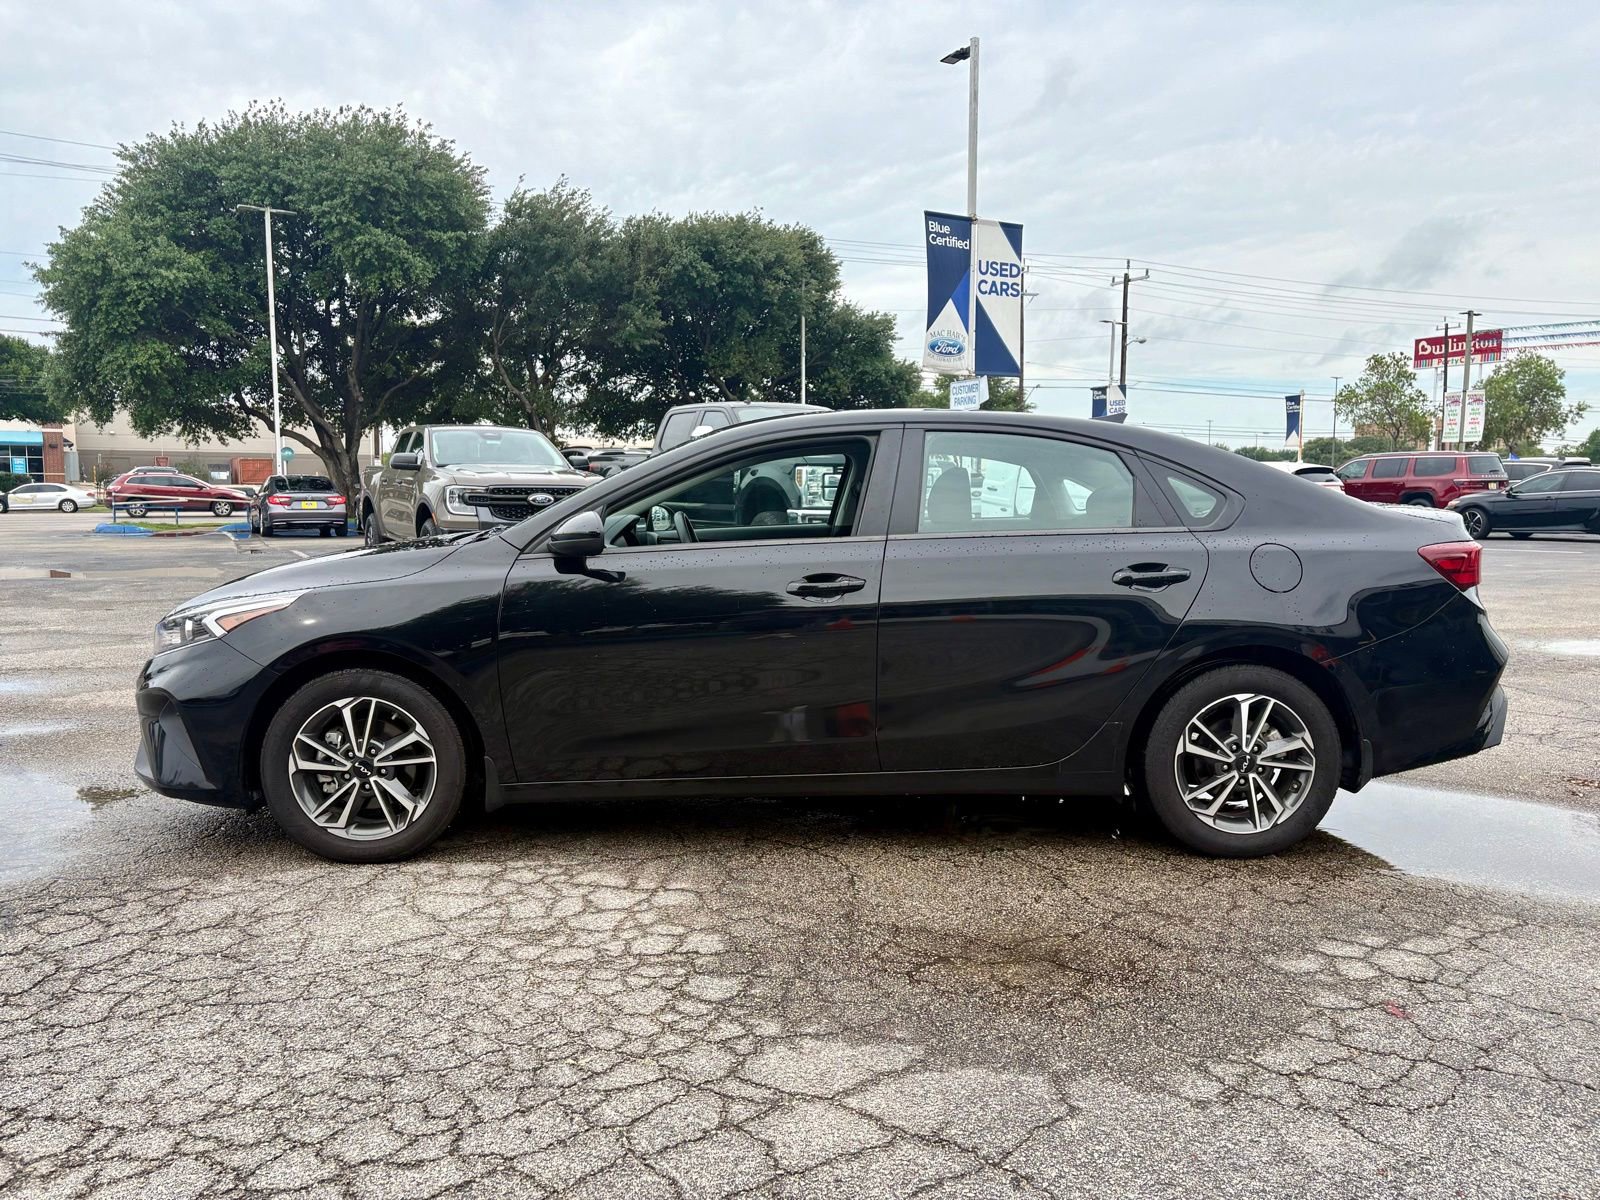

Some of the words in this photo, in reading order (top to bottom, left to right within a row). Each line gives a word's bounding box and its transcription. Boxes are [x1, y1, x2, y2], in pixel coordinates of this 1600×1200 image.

[928, 221, 950, 234] Blue
[928, 234, 970, 250] Certified
[978, 260, 1021, 278] USED
[977, 280, 1021, 297] CARS
[935, 340, 960, 354] Ford
[1460, 356, 1476, 364] Cy
[952, 384, 979, 396] CUSTOMER
[953, 395, 977, 407] PARKING
